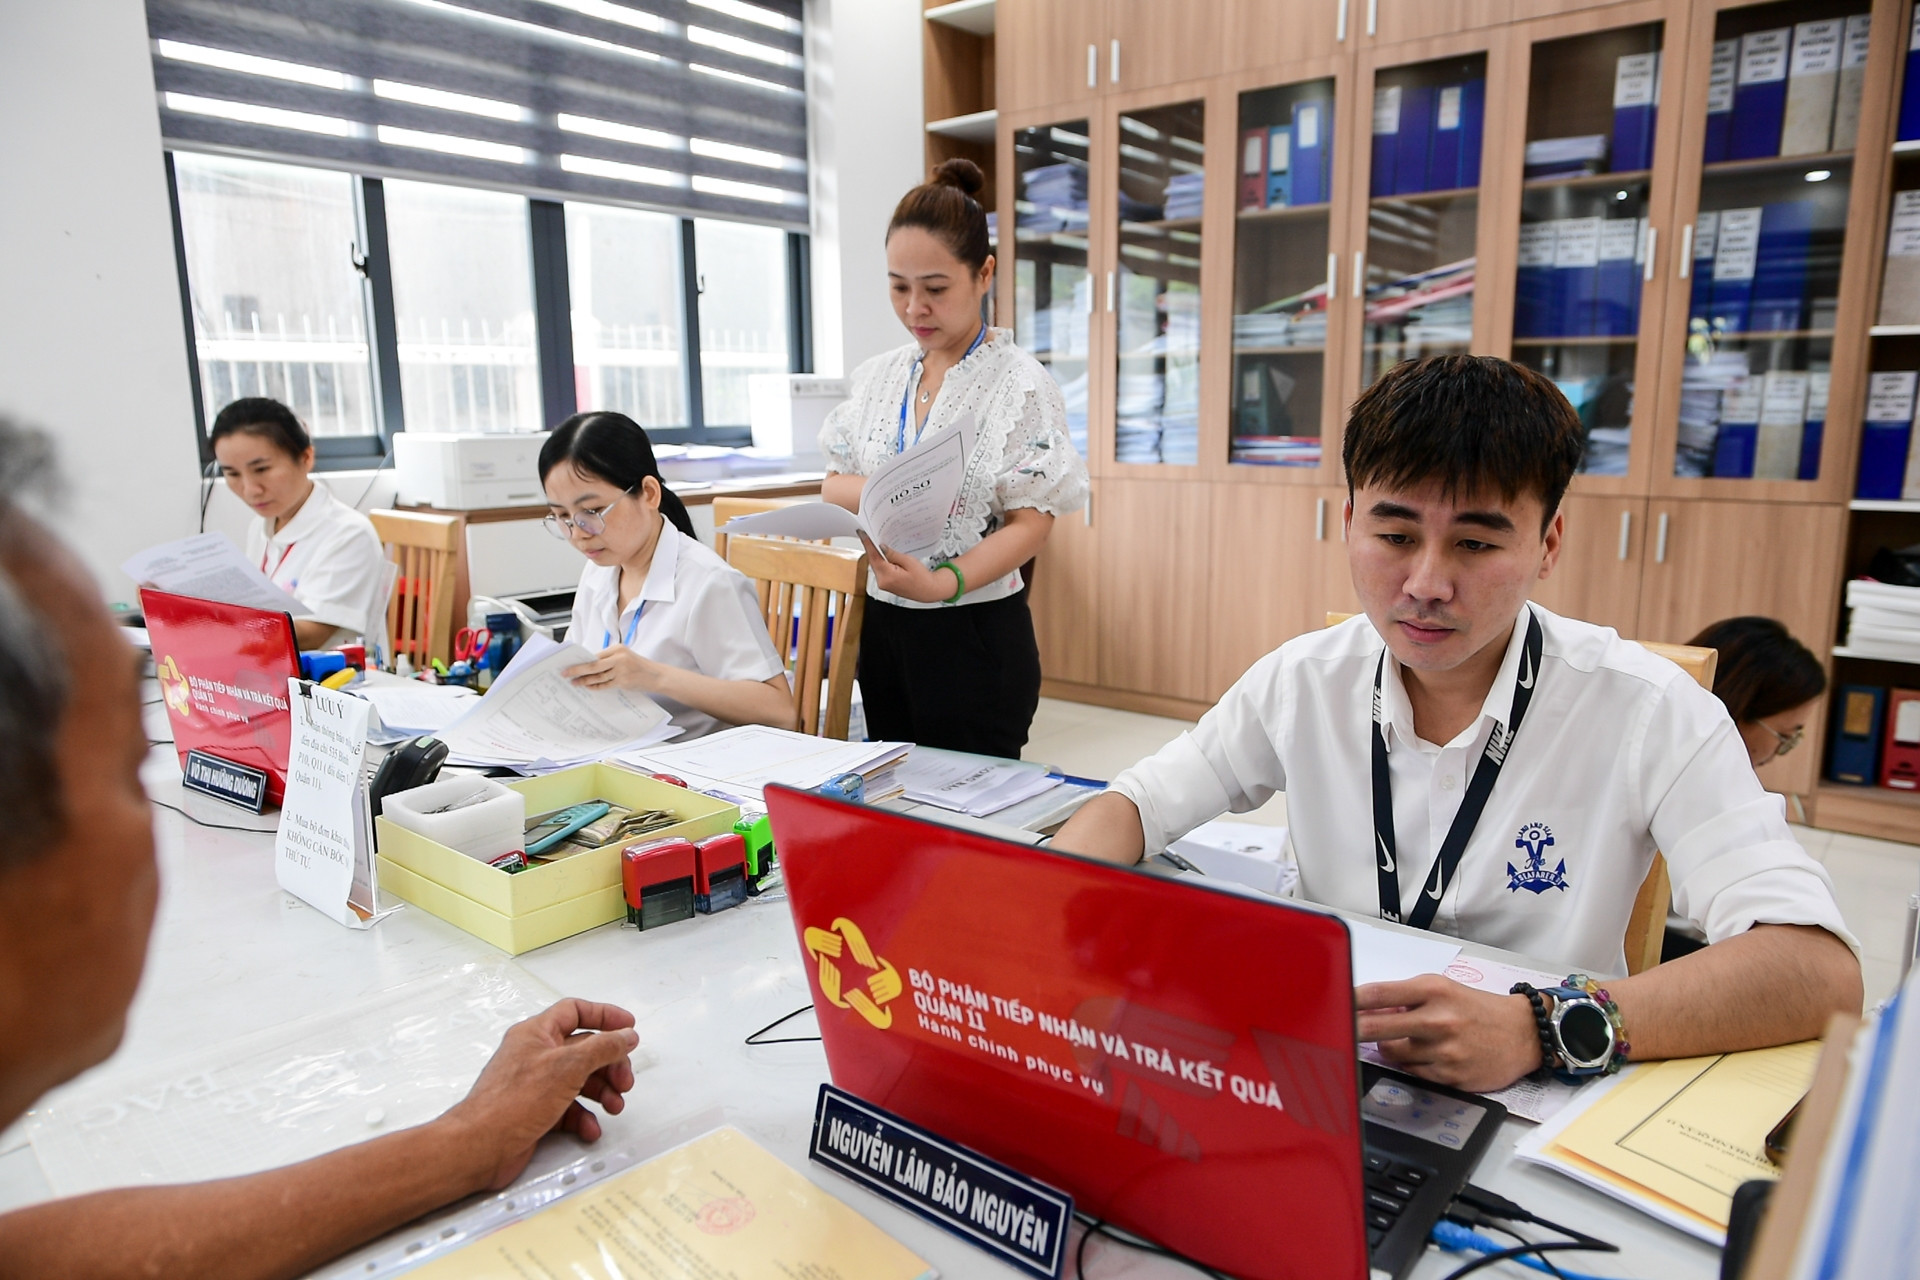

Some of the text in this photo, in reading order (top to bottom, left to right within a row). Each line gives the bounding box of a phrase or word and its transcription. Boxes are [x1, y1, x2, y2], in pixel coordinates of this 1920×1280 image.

[286, 829, 312, 850] KHÔNG
[908, 967, 1284, 1111] BỘ PHẬN TIẾP NHẬN VÀ TRẢ KẾT QUẢ
[913, 989, 987, 1033] QUẬN 11
[917, 1014, 1105, 1097] Hành chính phục vụ
[828, 1117, 1050, 1257] NGUYỄN LÂM BẢO NGUYÊN
